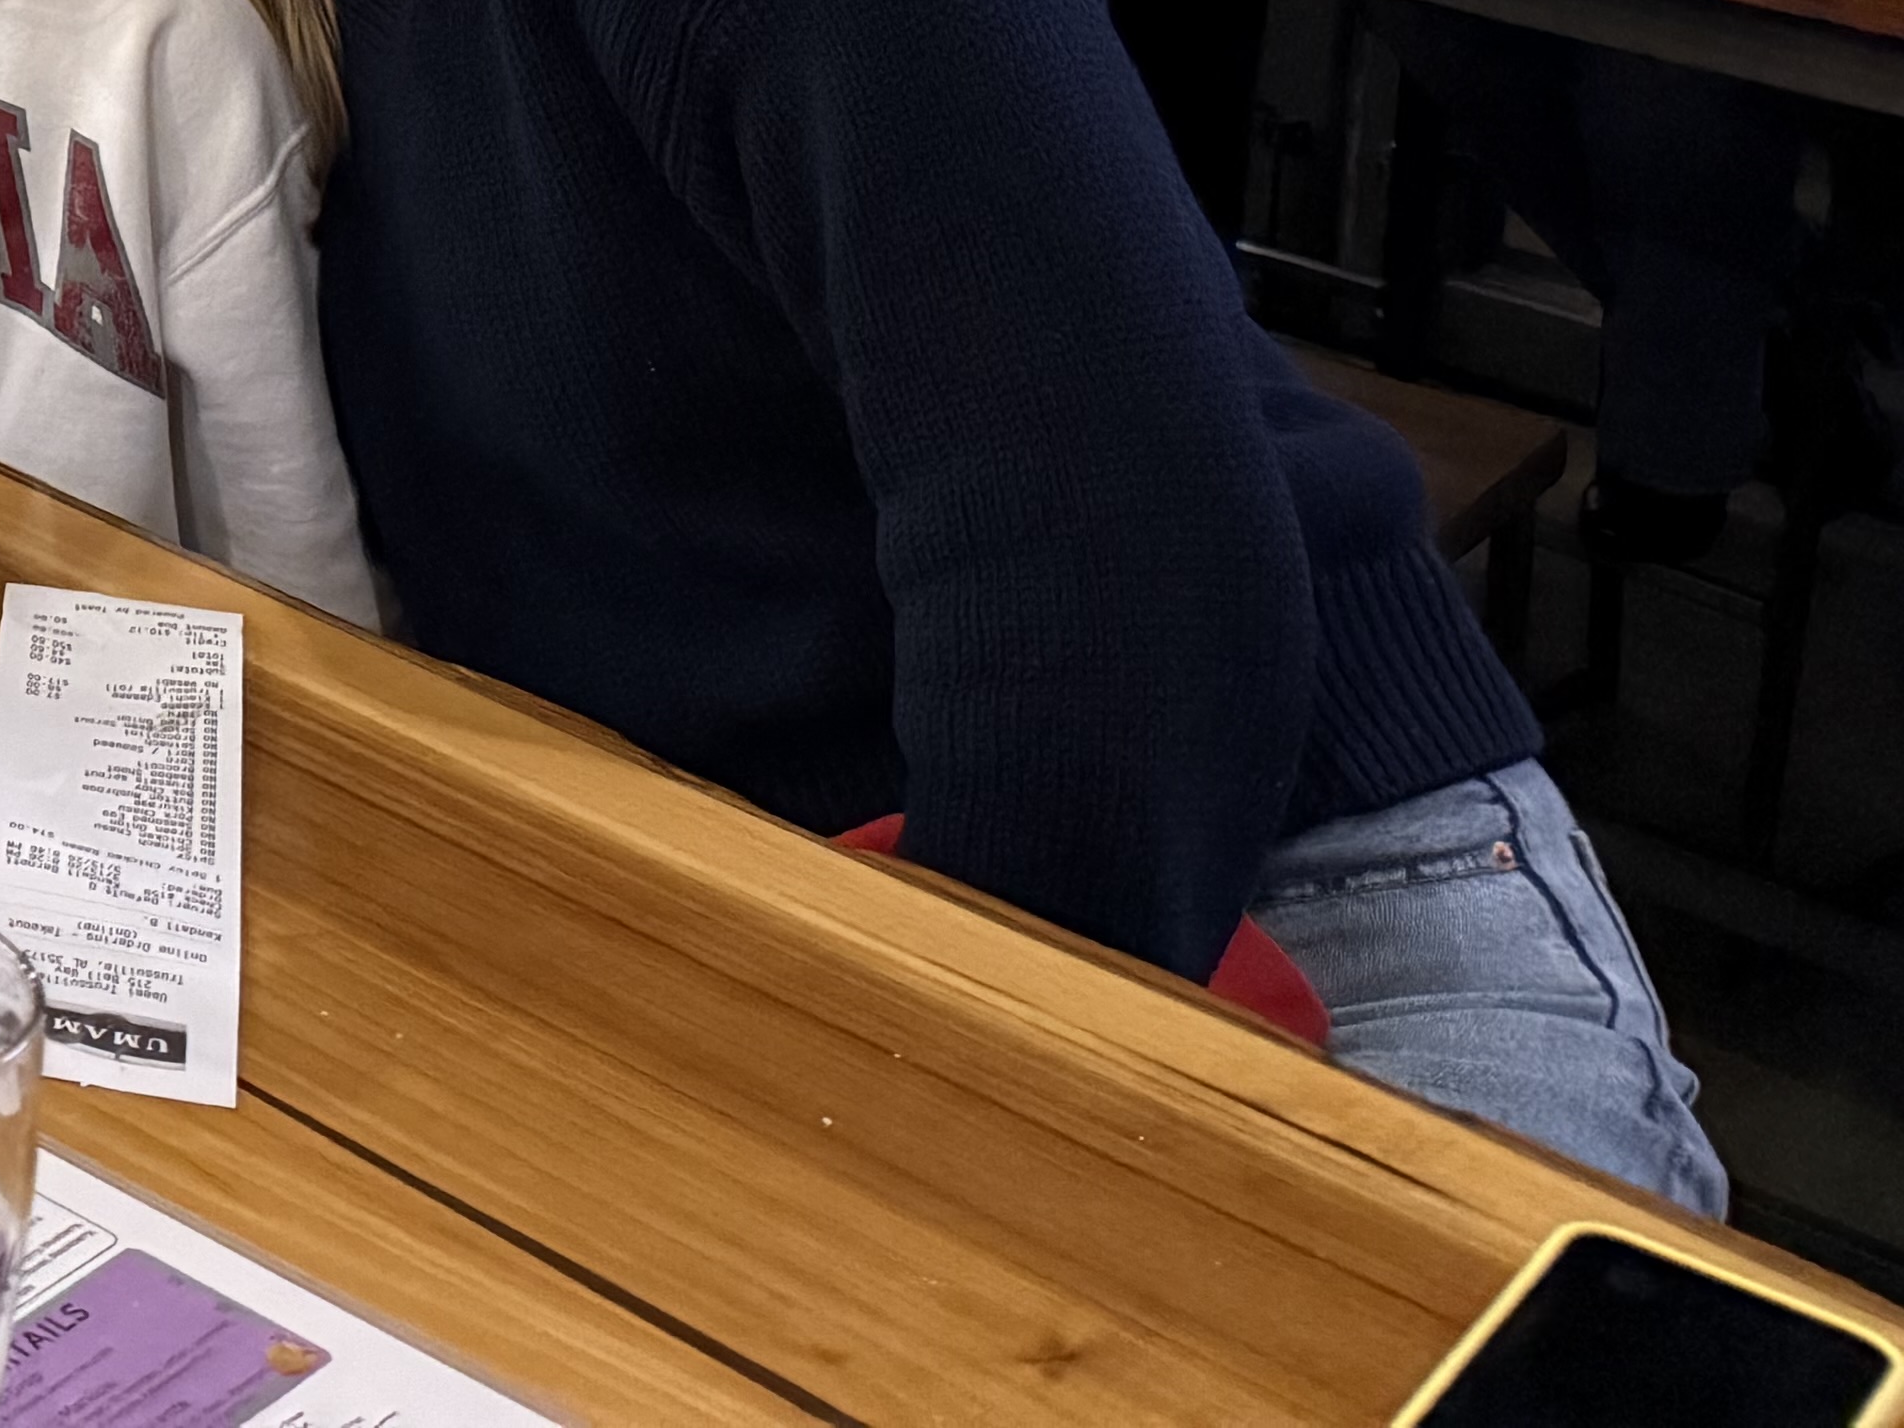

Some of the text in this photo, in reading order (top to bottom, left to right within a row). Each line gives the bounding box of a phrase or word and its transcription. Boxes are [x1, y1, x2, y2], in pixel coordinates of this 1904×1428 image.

[8, 918, 60, 938] Takeout
[77, 921, 138, 939] (Online)
[167, 921, 222, 942] Kendall
[86, 933, 151, 953] Ordering
[158, 945, 207, 963] Online
[53, 1017, 168, 1053] UMAM
